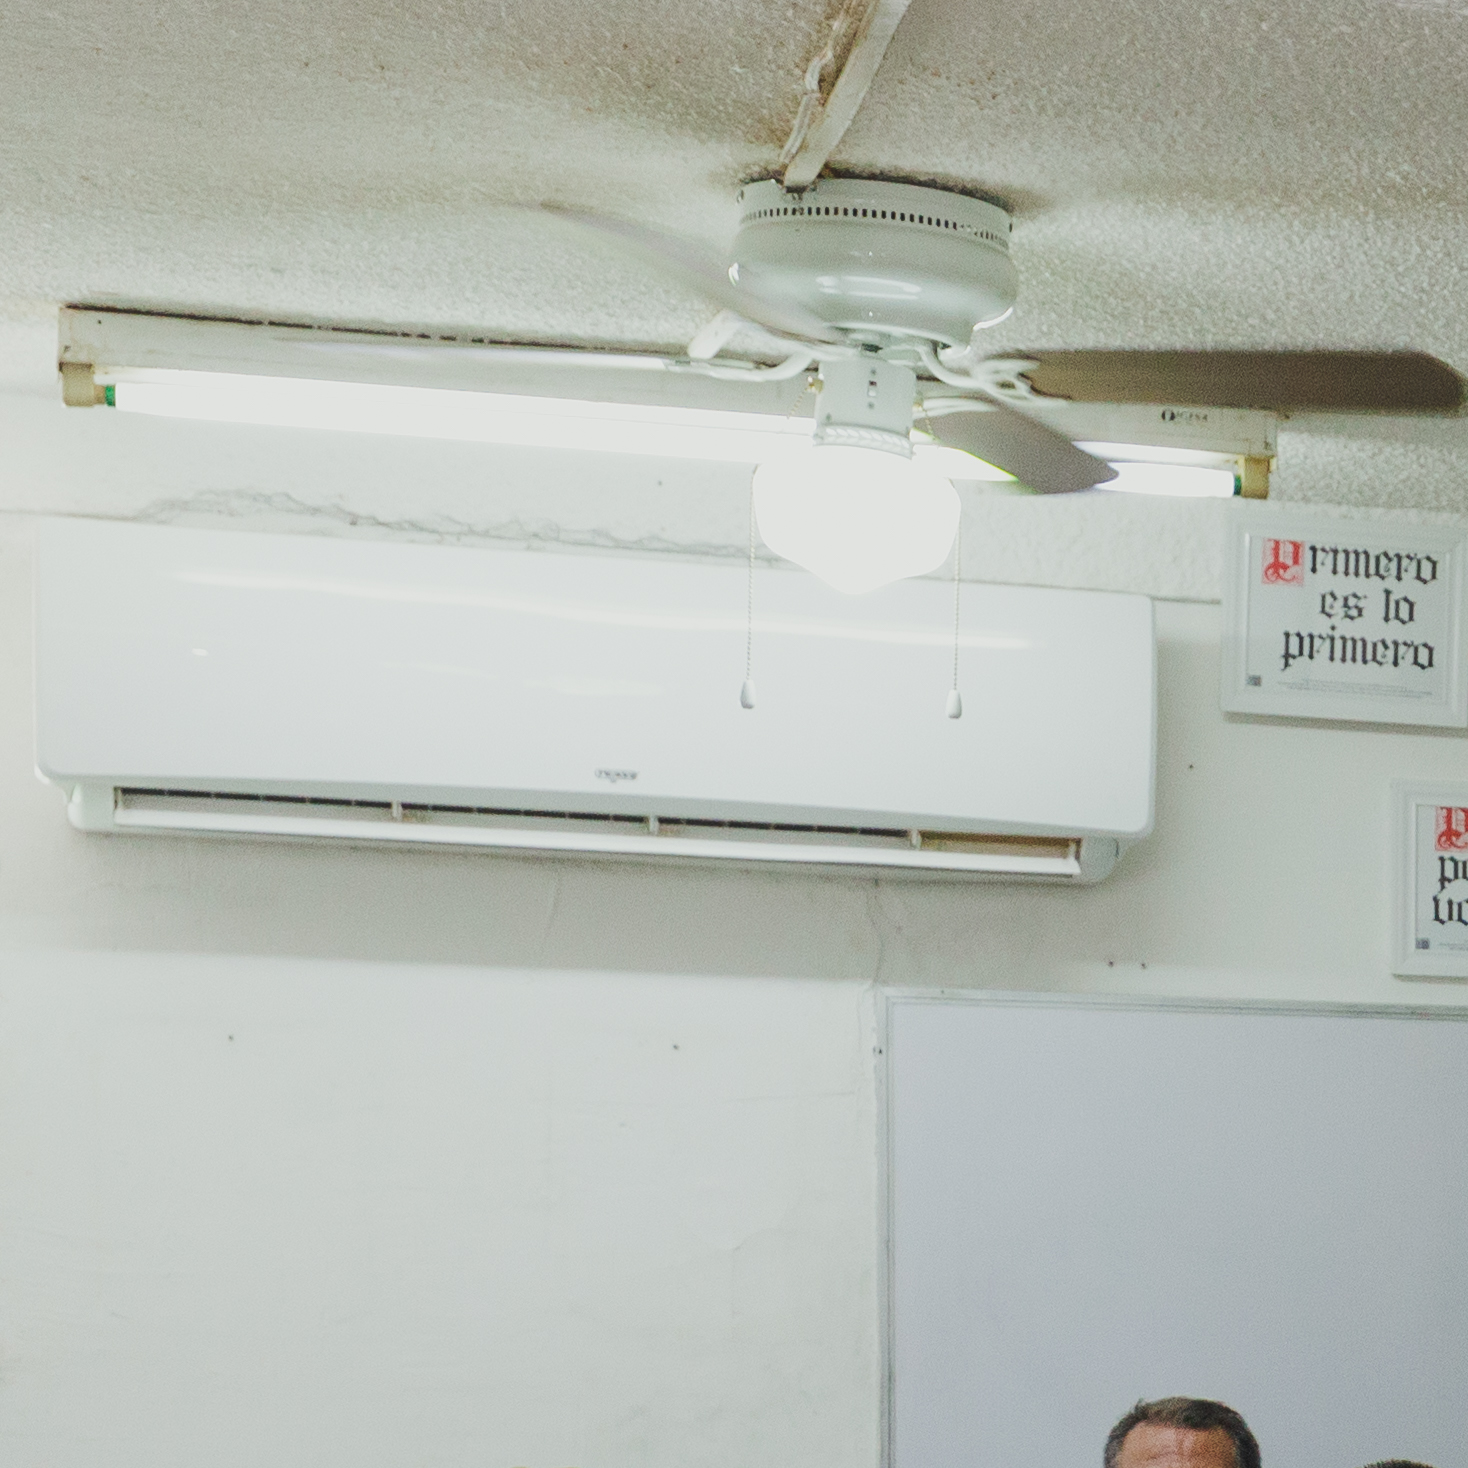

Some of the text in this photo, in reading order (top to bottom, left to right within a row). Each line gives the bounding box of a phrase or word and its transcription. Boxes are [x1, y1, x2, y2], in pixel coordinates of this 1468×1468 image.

[1262, 537, 1438, 585] Primero
[1319, 587, 1416, 625] es lo
[1280, 624, 1434, 672] primero
